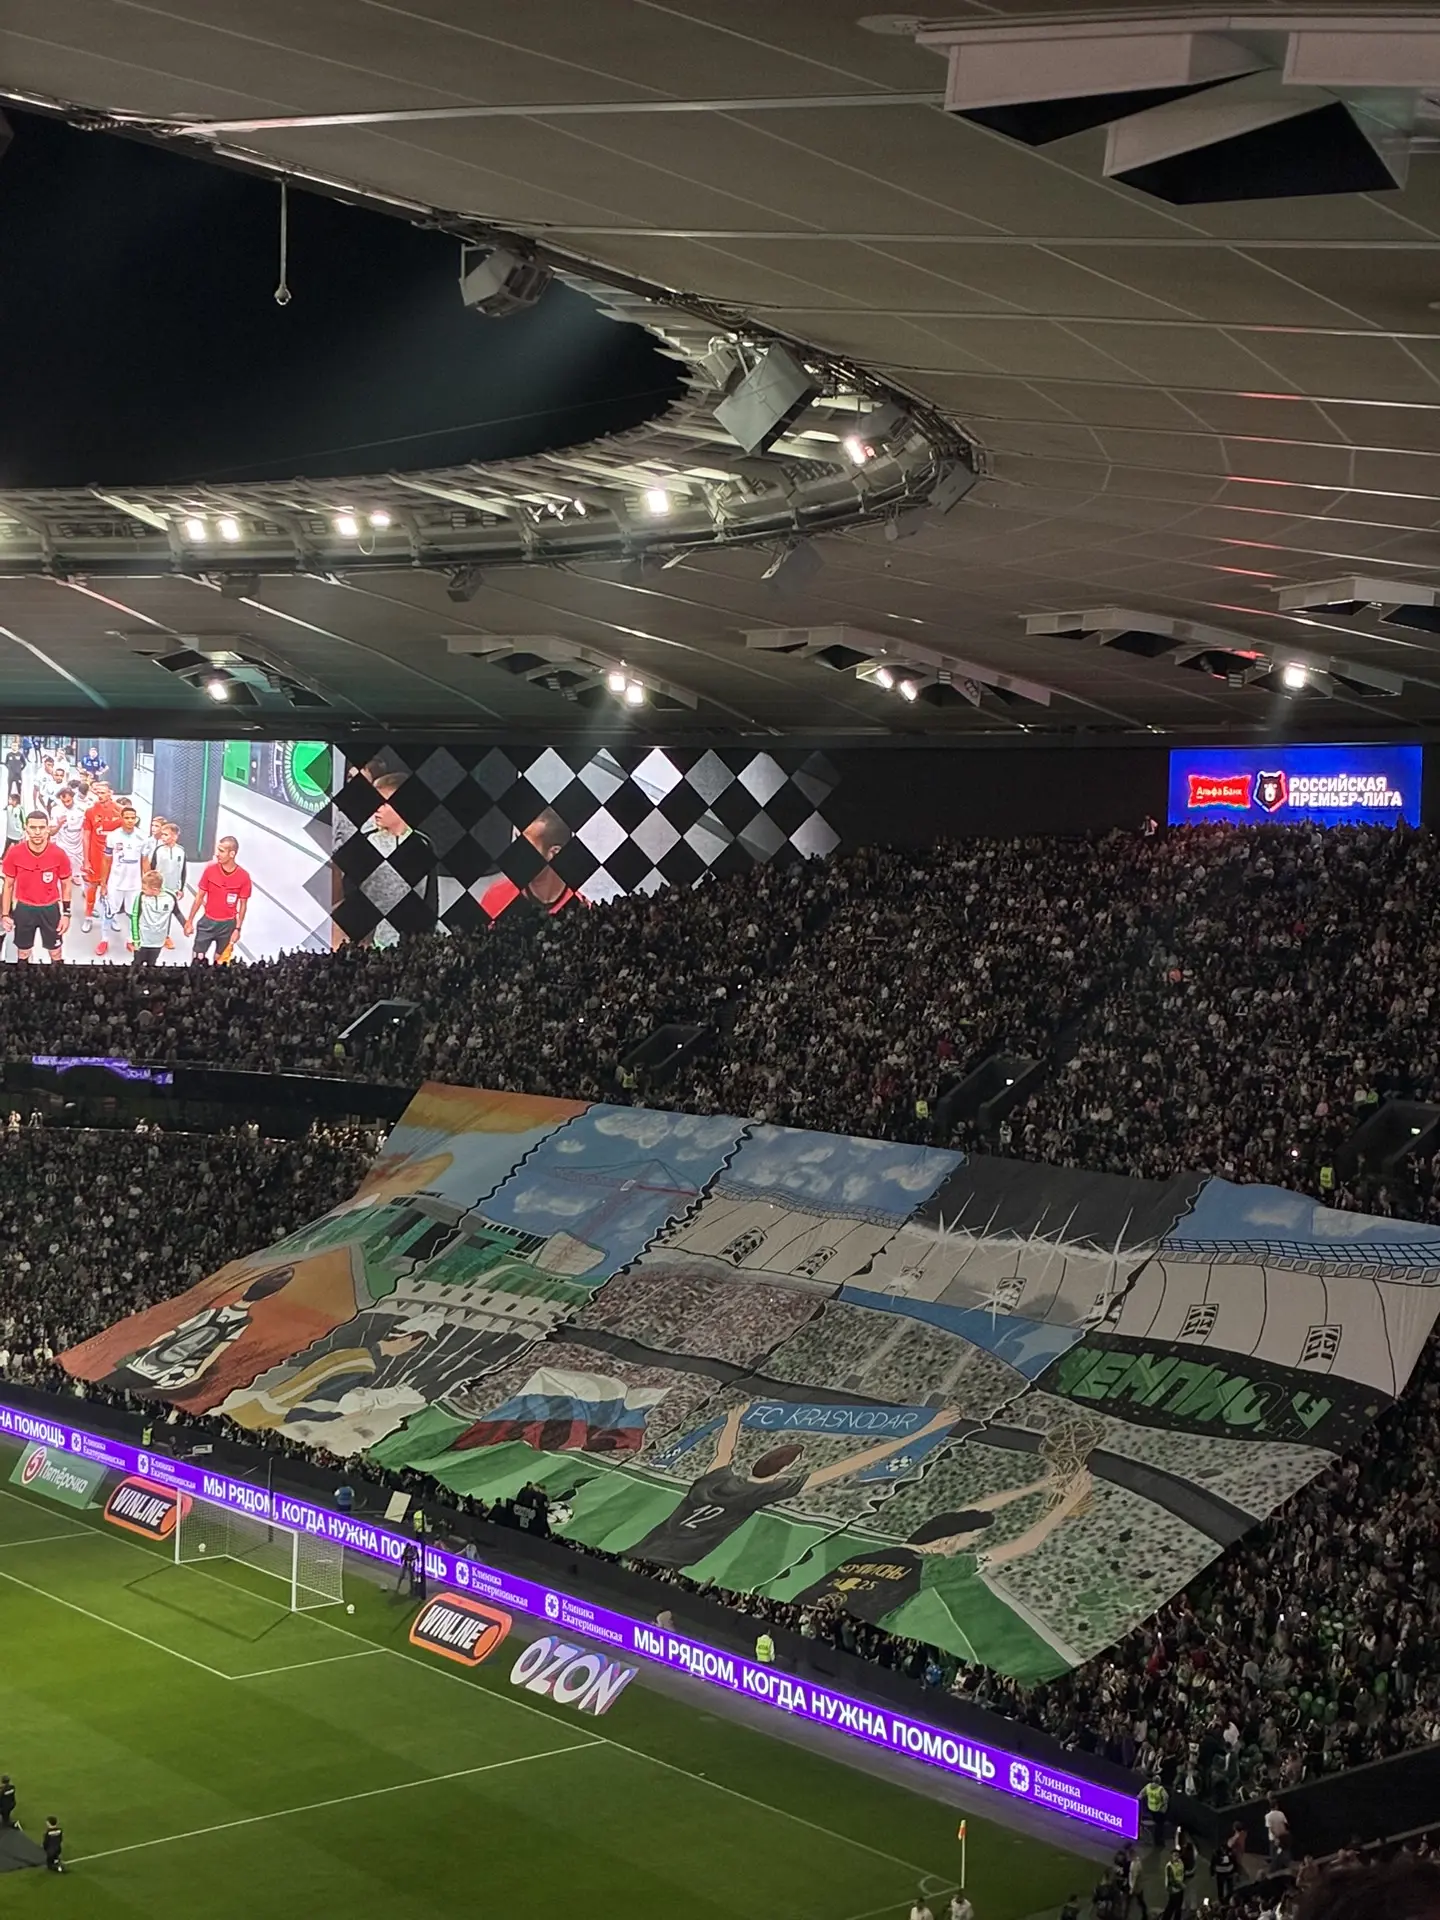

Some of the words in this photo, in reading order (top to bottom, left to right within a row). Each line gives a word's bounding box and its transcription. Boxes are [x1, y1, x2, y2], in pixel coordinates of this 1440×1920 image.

[1289, 774, 1387, 791] РОССИЙСКАЯ
[1288, 792, 1402, 808] ПРЕМЬЕР-ЛИГА
[14, 1415, 66, 1448] ПОМОЩЬ
[747, 1405, 784, 1425] FC
[785, 1408, 919, 1429] KRASNODAR
[111, 1487, 169, 1527] WINLINE
[680, 1505, 725, 1529] 12
[203, 1475, 226, 1499] МЫ
[281, 1501, 326, 1535] КОГДА
[328, 1516, 378, 1553] НУЖНА
[381, 1535, 447, 1578] ПОЩЬ
[472, 1567, 502, 1586] Клиника
[562, 1599, 595, 1621] Клиника
[417, 1605, 488, 1649] WINLINE
[562, 1613, 623, 1643] Екатерининская
[510, 1636, 639, 1715] OZON
[634, 1627, 665, 1655] МЫ
[669, 1643, 740, 1688] РЯДОМ,
[742, 1666, 807, 1709] КОГДА
[812, 1690, 887, 1740] НУЖНА
[892, 1722, 995, 1781] ПОМОЩЬ
[1034, 1769, 1081, 1797] Клиника
[1034, 1784, 1123, 1828] Екатерининская
